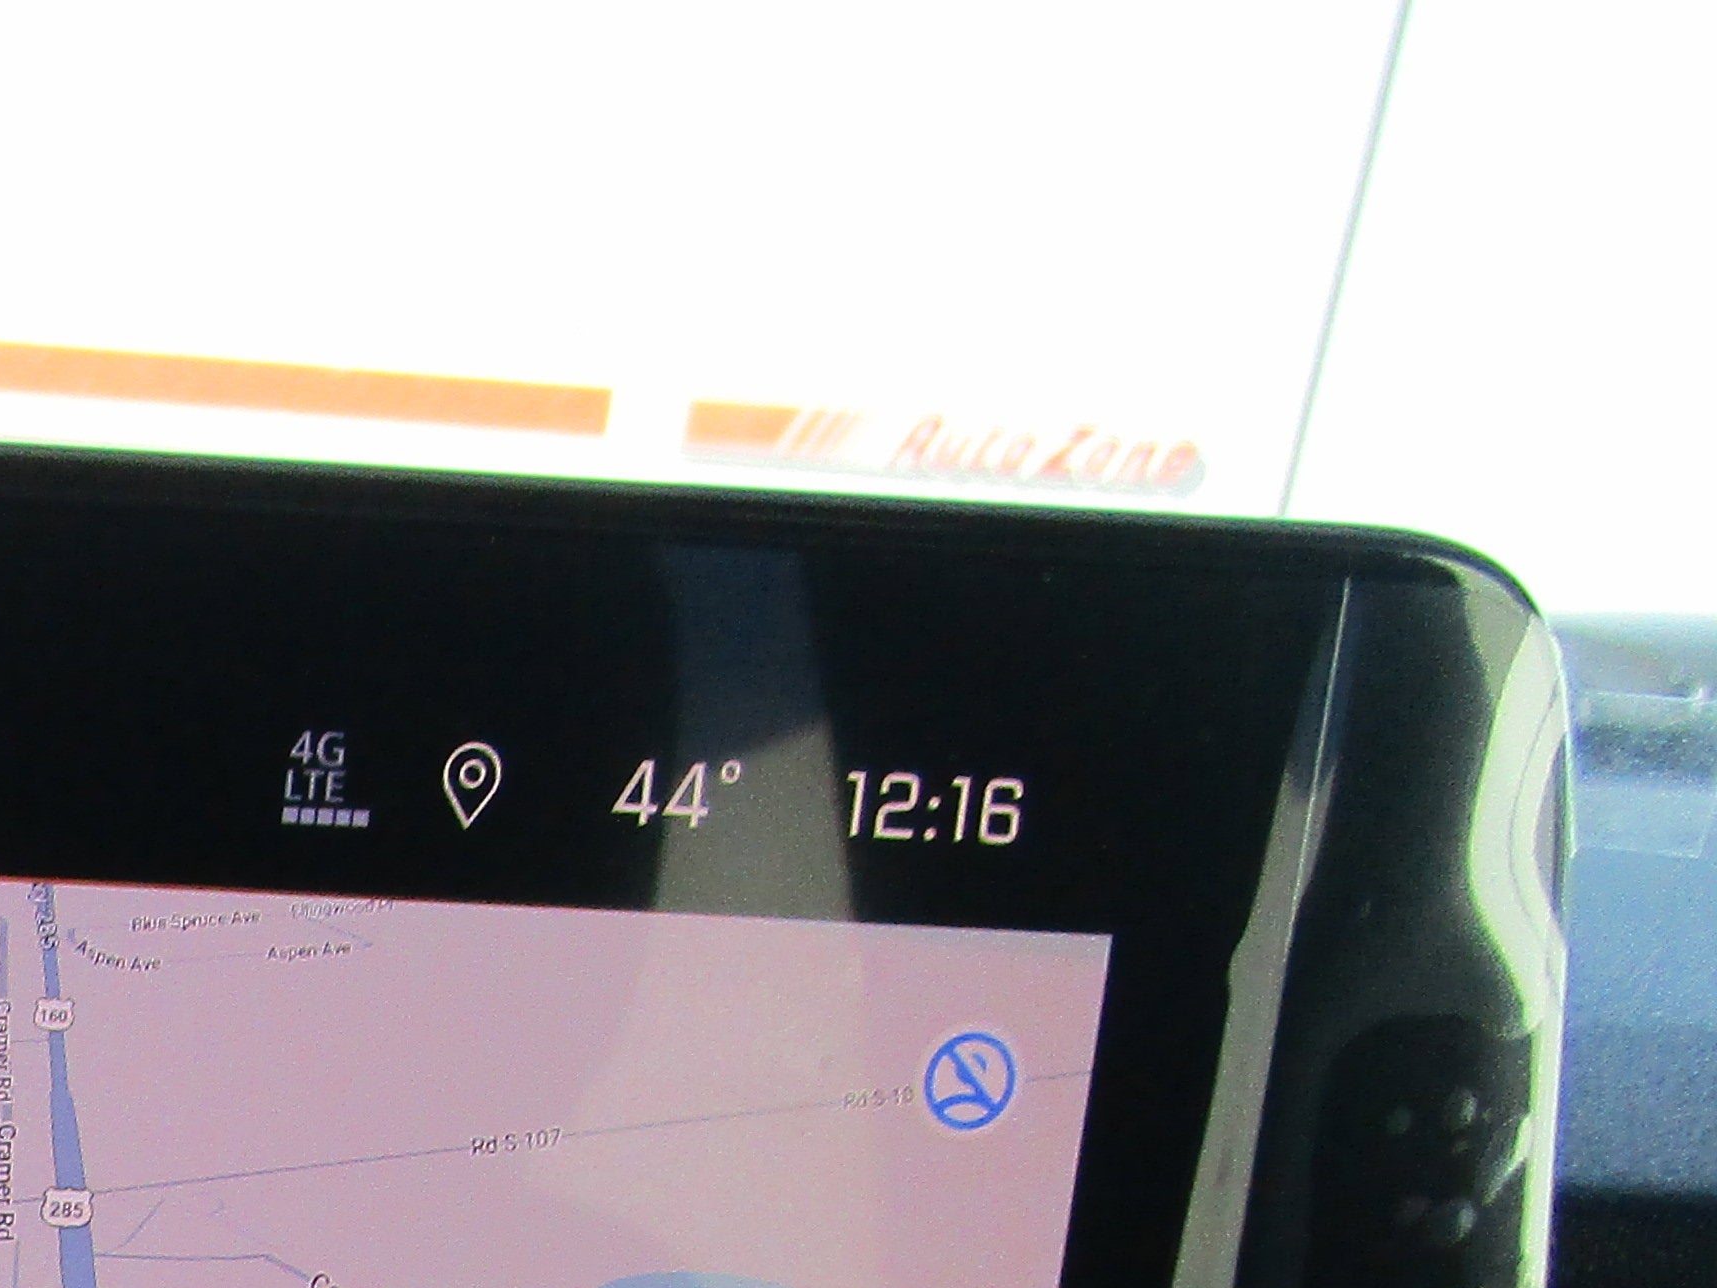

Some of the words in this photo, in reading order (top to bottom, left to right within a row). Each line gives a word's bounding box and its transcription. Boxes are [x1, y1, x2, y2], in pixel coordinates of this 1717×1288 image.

[897, 414, 1202, 490] AutoZone
[290, 730, 345, 766] 4G
[285, 770, 345, 803] LTE
[613, 760, 741, 829] 44°
[847, 769, 1024, 846] 12:16
[38, 1008, 68, 1024] 160
[471, 1135, 497, 1155] Rd
[503, 1133, 518, 1152] S
[525, 1128, 561, 1149] 107
[49, 1201, 83, 1219] 285
